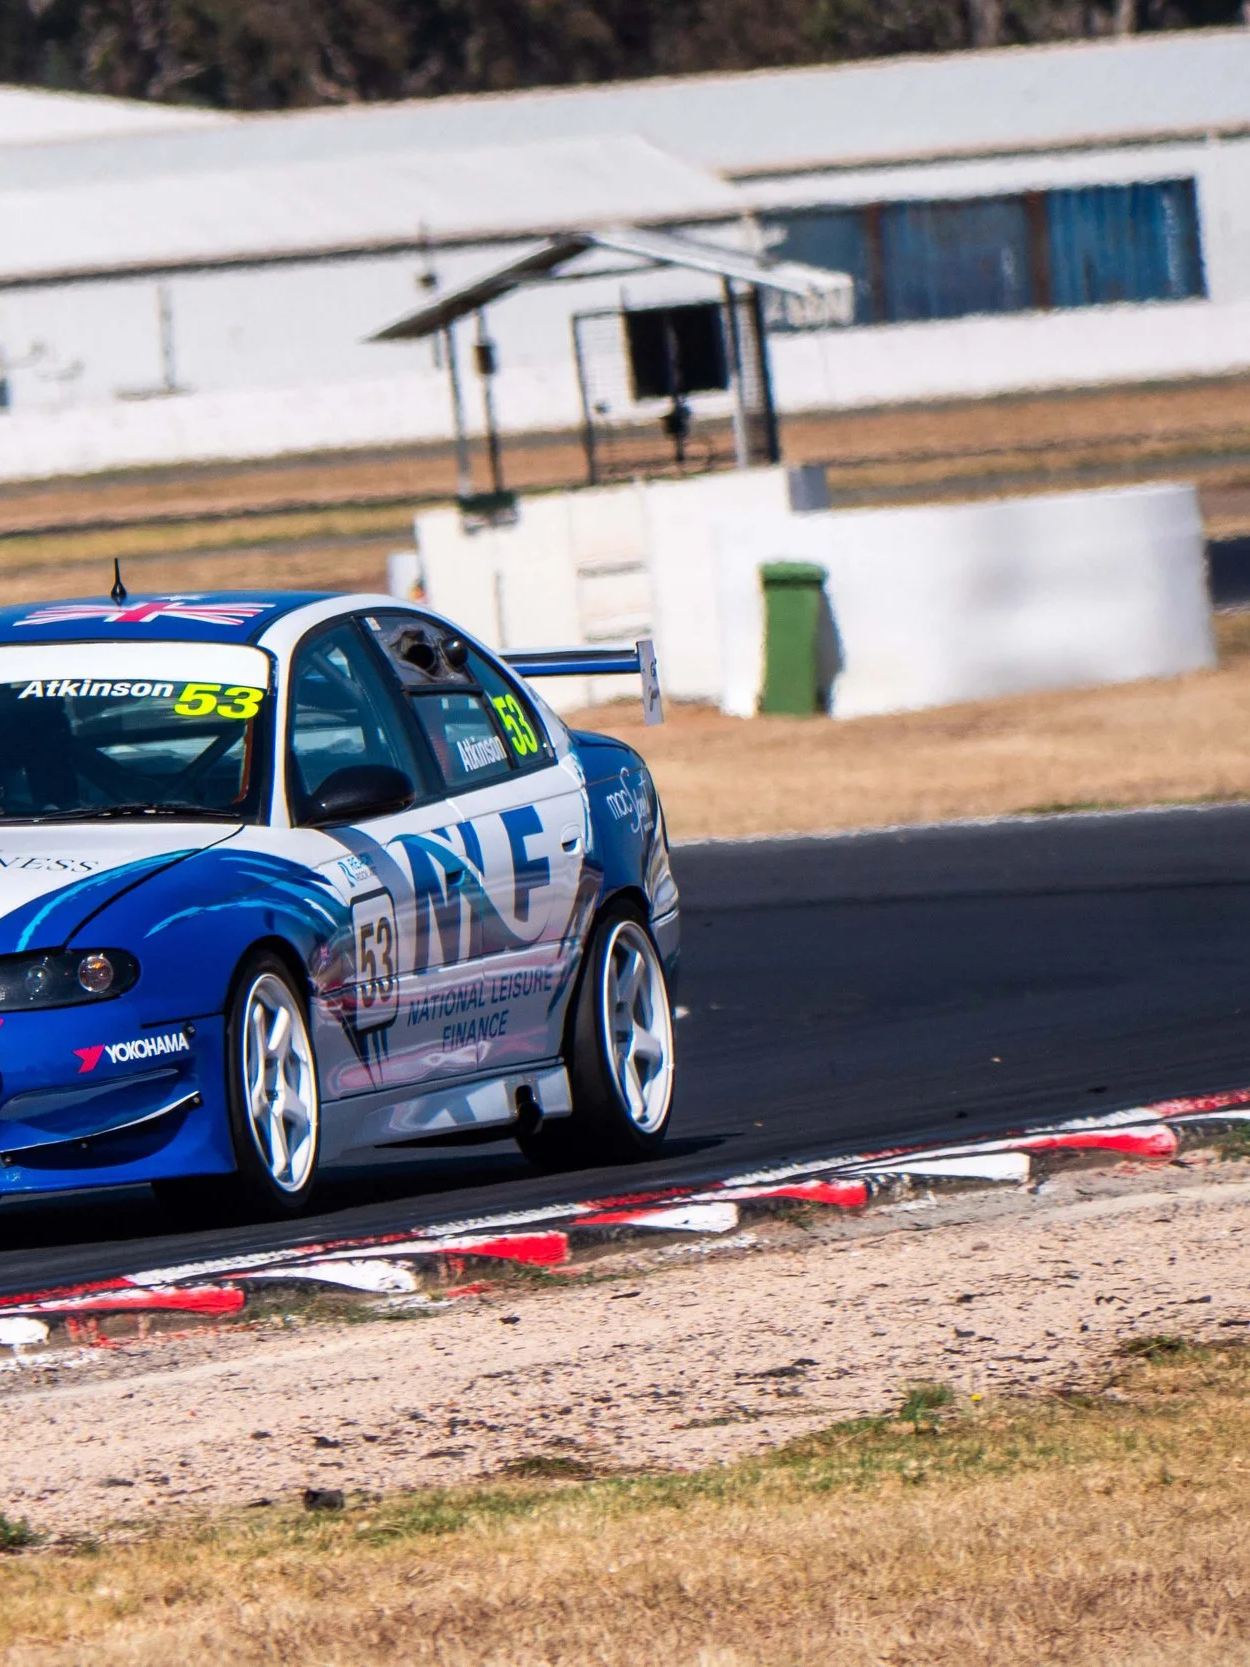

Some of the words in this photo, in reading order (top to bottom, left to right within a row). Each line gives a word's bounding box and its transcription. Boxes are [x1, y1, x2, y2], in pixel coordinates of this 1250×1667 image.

[18, 679, 174, 699] Atkinson
[174, 683, 264, 719] 53
[492, 694, 538, 756] 53
[456, 735, 508, 773] Atkinson
[359, 917, 395, 1008] 53
[406, 974, 486, 1028] NATIONAL
[490, 966, 552, 1005] LEISURE
[104, 1032, 190, 1064] YOKOHAMA
[441, 1009, 510, 1052] FINANCE
